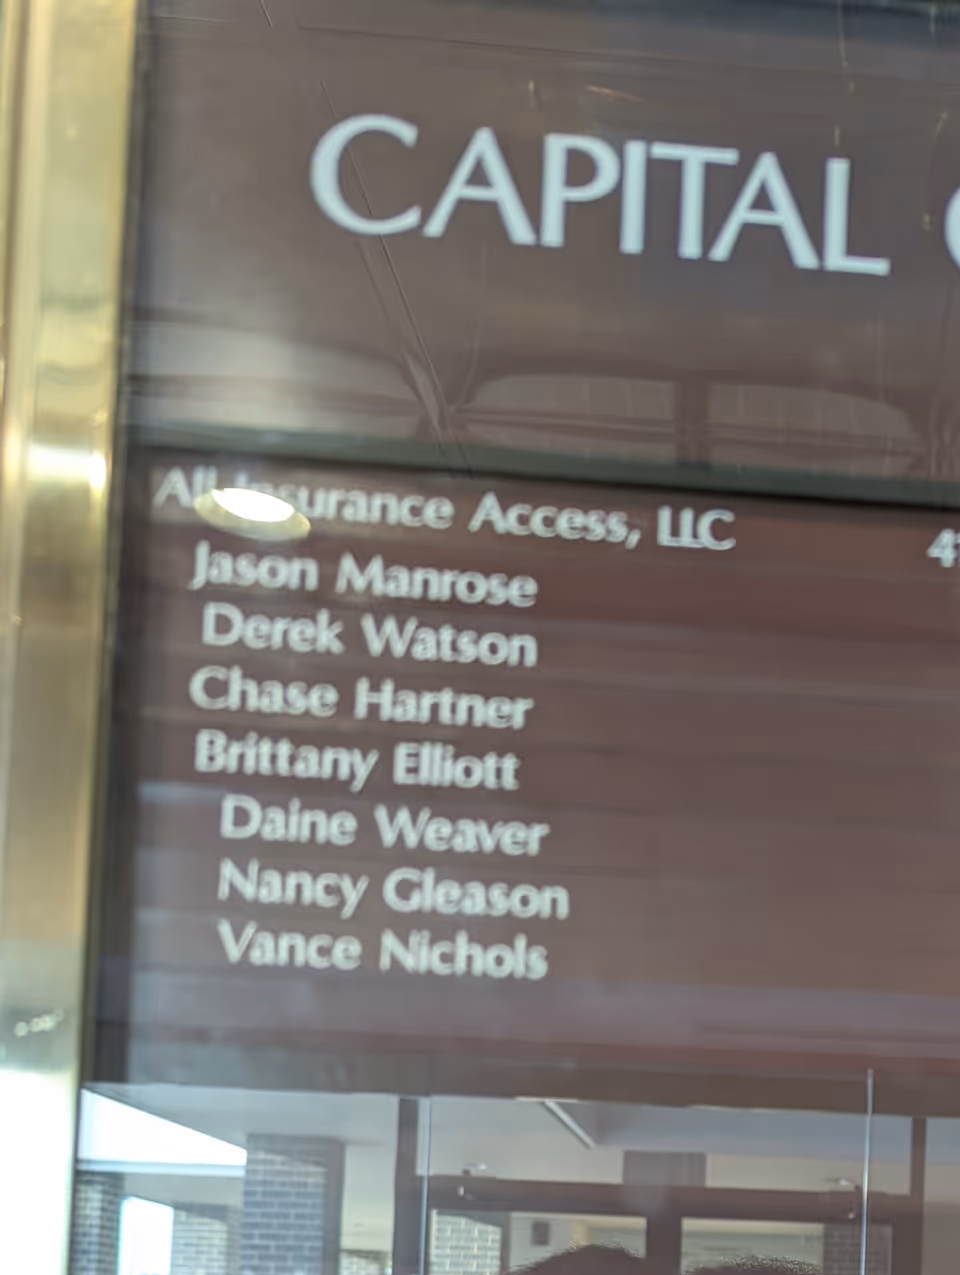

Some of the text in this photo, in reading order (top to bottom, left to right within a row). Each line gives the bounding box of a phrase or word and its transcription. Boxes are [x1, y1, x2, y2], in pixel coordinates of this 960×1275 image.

[309, 113, 892, 278] CAPITAL
[469, 492, 642, 551] Access,
[656, 506, 736, 551] LLC
[188, 541, 538, 608] Jason Manrose
[201, 603, 538, 668] Derek Watson
[188, 666, 535, 731] Chase Hartner
[194, 729, 520, 793] Brittany Elliott
[220, 795, 550, 858] Daine Weaver
[217, 860, 570, 921] Nancy Gleason
[216, 922, 549, 981] Vance Nichols
